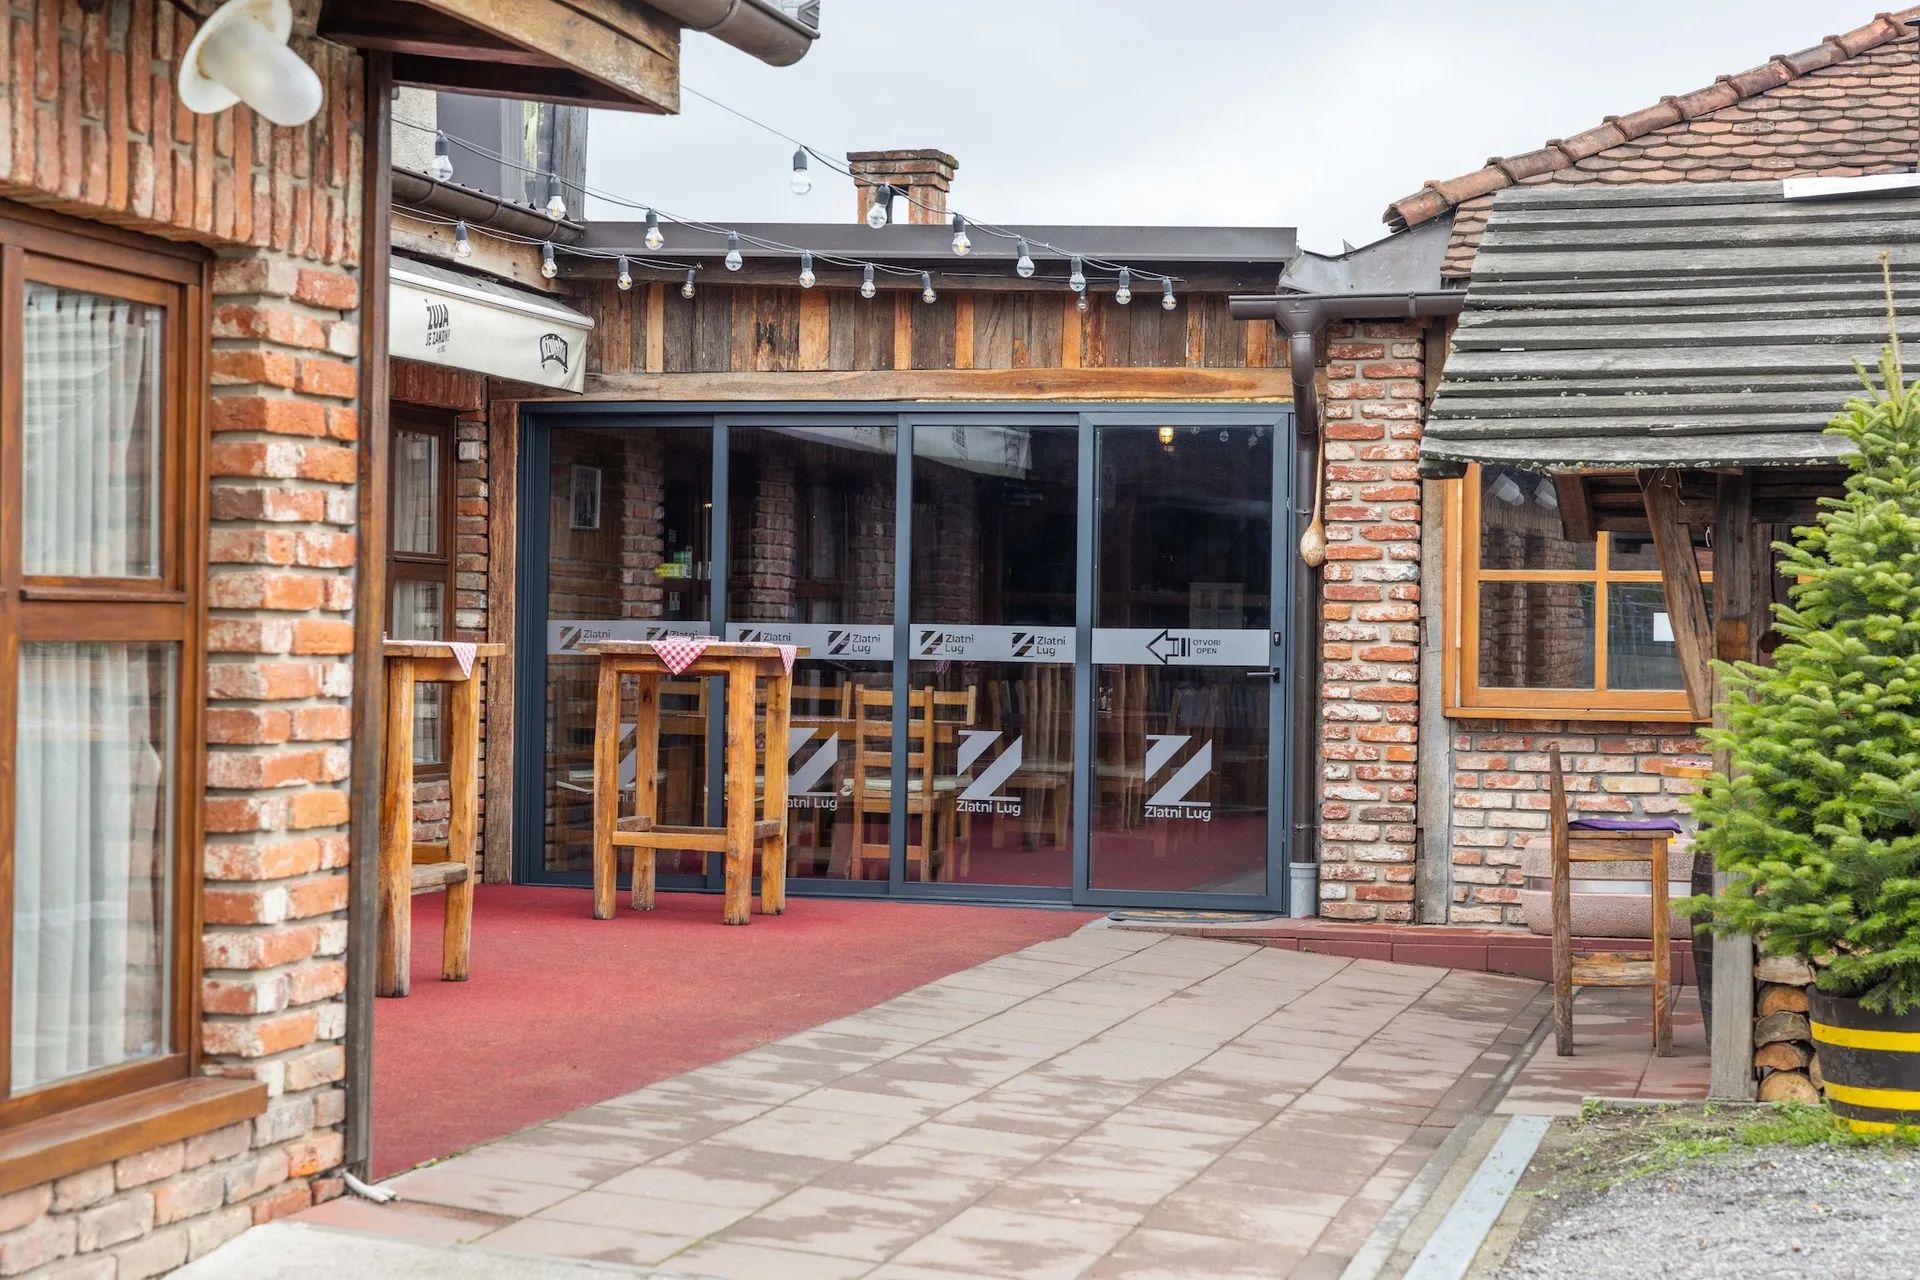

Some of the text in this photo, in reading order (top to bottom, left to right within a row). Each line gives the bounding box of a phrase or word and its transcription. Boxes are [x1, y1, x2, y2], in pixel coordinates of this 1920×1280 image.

[424, 298, 449, 330] ŽUJA
[583, 629, 611, 639] Zlatni
[763, 632, 791, 642] Zlatni
[852, 634, 881, 643] Zlatni
[945, 634, 974, 644] Zlatni
[1037, 636, 1066, 646] Zlatni
[852, 643, 871, 654] Lug
[945, 643, 964, 655] Lug
[1036, 646, 1056, 656] Lug
[787, 797, 838, 811] atni Lug
[956, 800, 1021, 817] Zlatni Lug
[1144, 805, 1211, 822] Zlatni Lug
